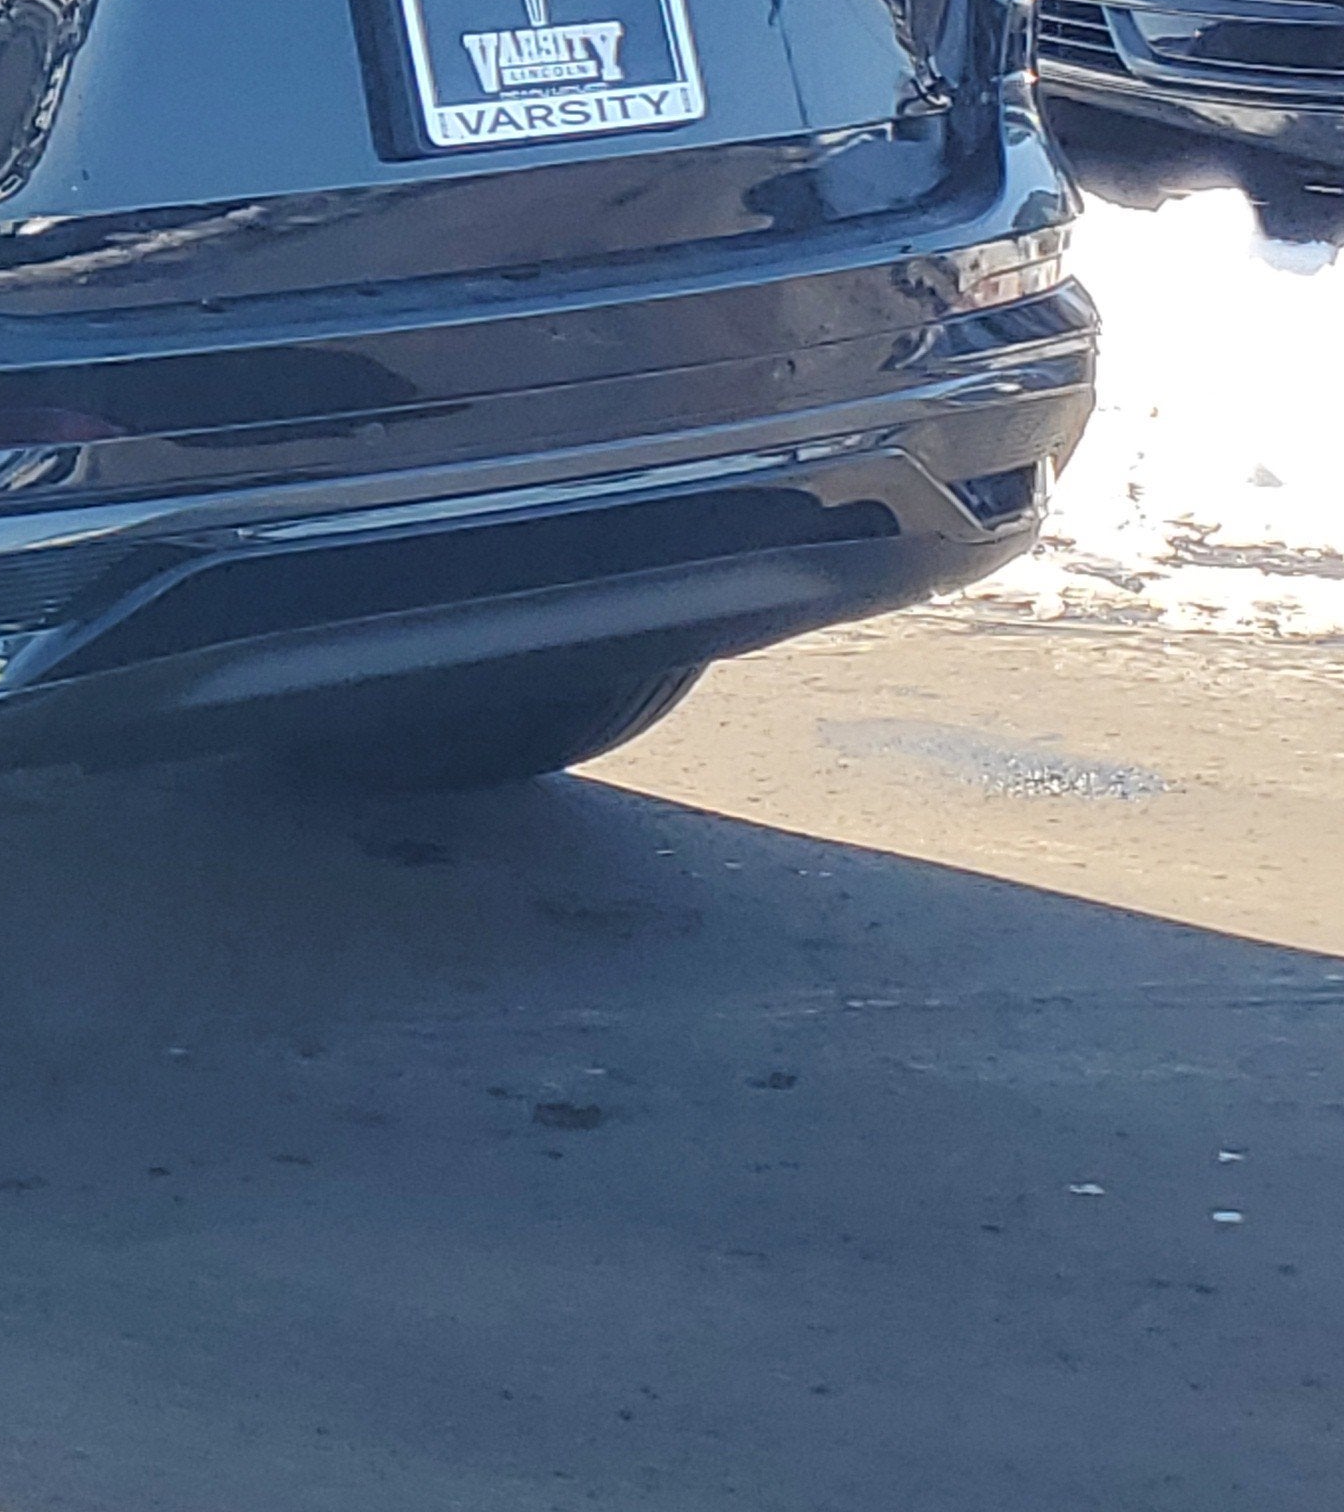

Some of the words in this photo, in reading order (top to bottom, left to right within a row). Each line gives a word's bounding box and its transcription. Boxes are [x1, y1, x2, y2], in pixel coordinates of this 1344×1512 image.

[462, 20, 625, 94] VARSITY
[510, 63, 589, 82] LINCOLN
[455, 90, 670, 136] VARSITY
